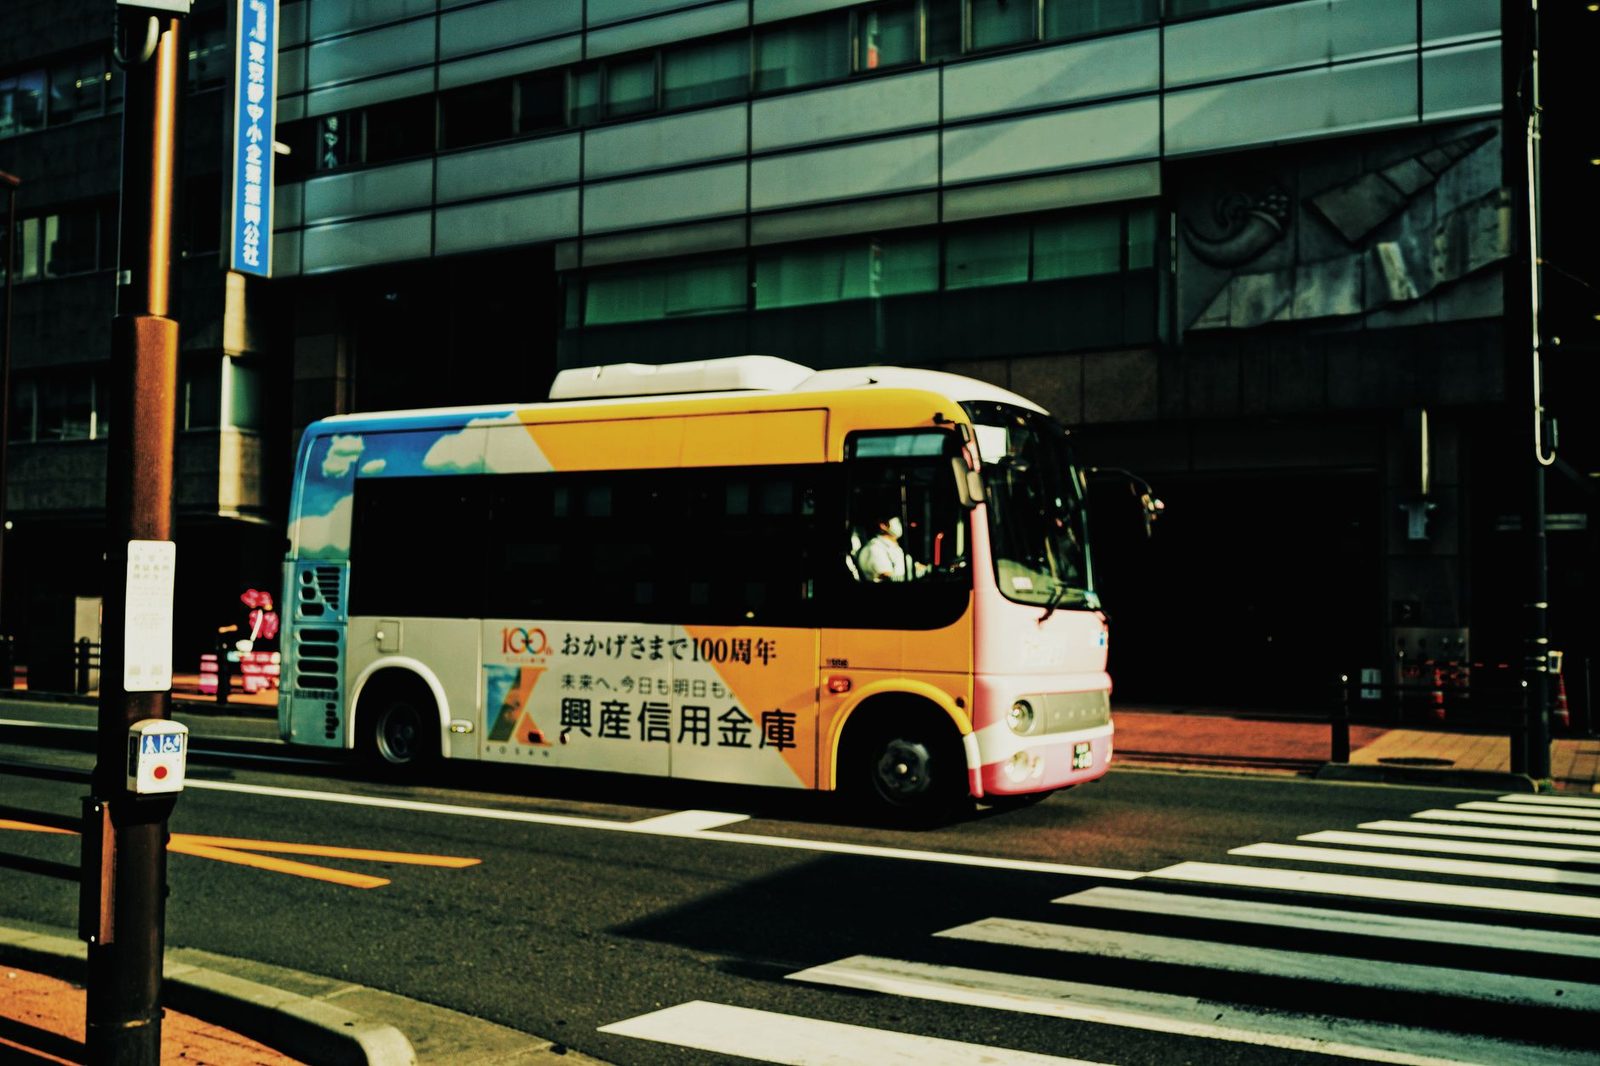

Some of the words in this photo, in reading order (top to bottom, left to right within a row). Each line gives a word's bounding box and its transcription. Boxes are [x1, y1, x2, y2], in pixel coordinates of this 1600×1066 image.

[560, 633, 777, 666] おかげさまで100周年
[560, 697, 797, 752] 興産信用金庫
